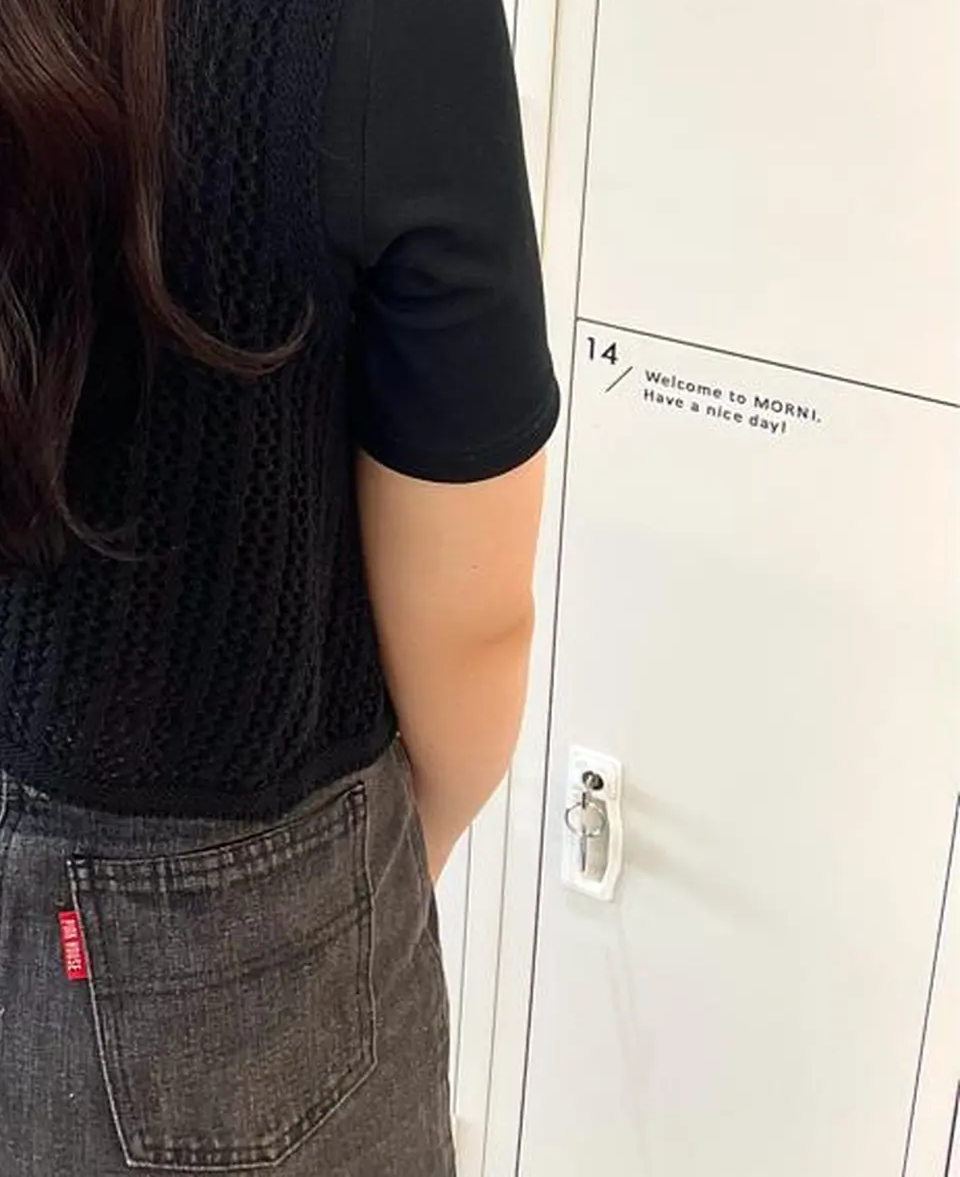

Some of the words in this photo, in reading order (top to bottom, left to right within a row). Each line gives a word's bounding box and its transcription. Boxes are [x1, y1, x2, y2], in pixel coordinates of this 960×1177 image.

[587, 336, 618, 365] 14
[643, 388, 684, 409] Have
[690, 402, 700, 413] a
[706, 403, 743, 424] nice
[748, 414, 787, 435] day!
[644, 369, 723, 399] Welcome
[729, 390, 747, 405] to
[753, 395, 822, 423] MORNI.
